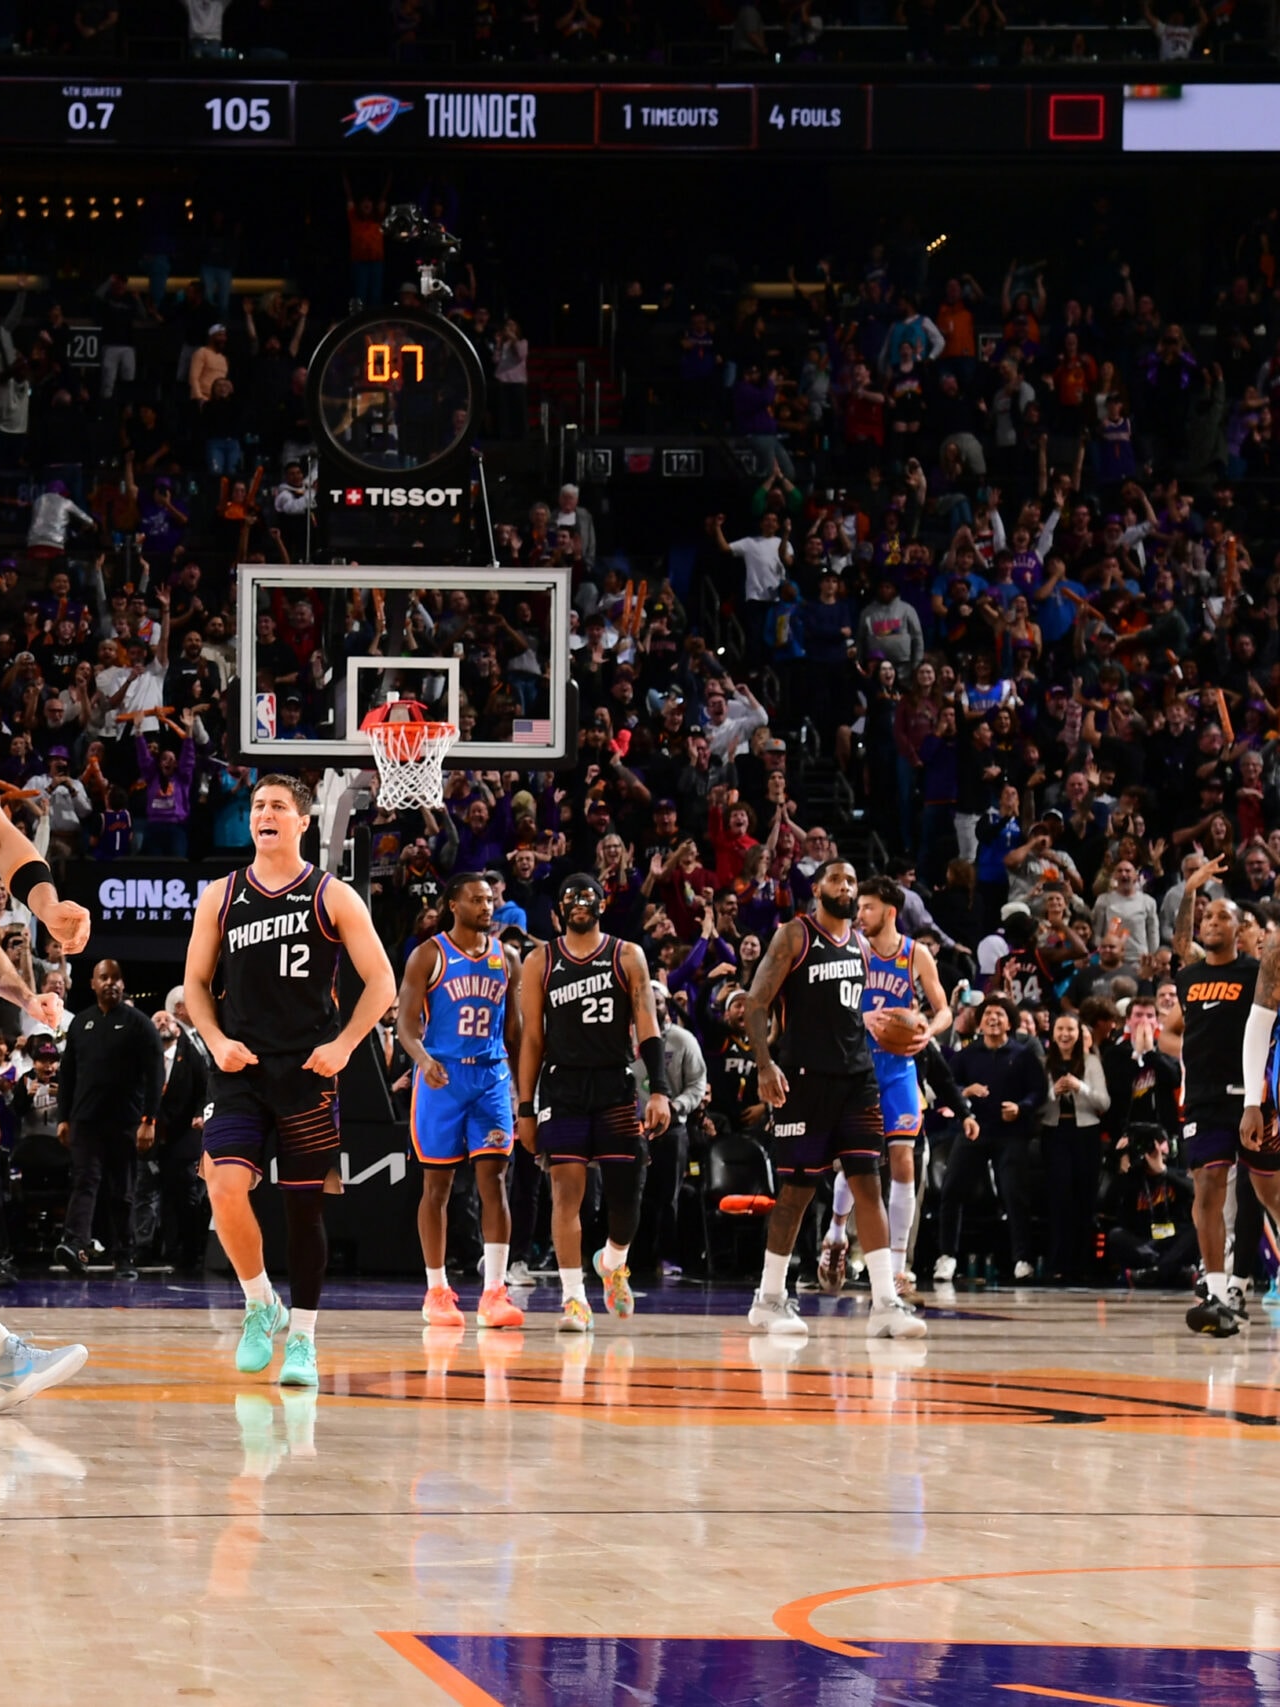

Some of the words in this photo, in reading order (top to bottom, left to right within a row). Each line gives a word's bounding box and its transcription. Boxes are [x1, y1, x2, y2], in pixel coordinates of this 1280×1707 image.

[61, 86, 80, 97] 4TH
[81, 86, 122, 98] QUARTER
[67, 102, 115, 130] 0.7
[204, 97, 272, 132] 105
[424, 93, 537, 138] THUNDER
[622, 104, 632, 130] 1
[641, 107, 719, 127] TIMEOUTS
[768, 104, 786, 130] 4
[790, 107, 842, 127] FOULS
[66, 335, 99, 359] 120
[367, 343, 424, 383] 0.7
[671, 454, 696, 473] 121
[365, 487, 463, 507] TISSOT
[286, 893, 313, 903] PayPal
[102, 909, 125, 921] BY
[136, 909, 173, 921] DRE
[227, 909, 311, 954] PHOENIX
[279, 943, 311, 978] 12
[808, 958, 864, 985] PHOENIX
[443, 974, 508, 1005] THUNDER
[549, 970, 614, 1008] PHOENIX
[839, 979, 864, 1010] 00
[1186, 981, 1244, 1002] SUNS
[457, 1005, 491, 1037] 22
[581, 996, 615, 1024] 23
[774, 1121, 807, 1138] SUNS
